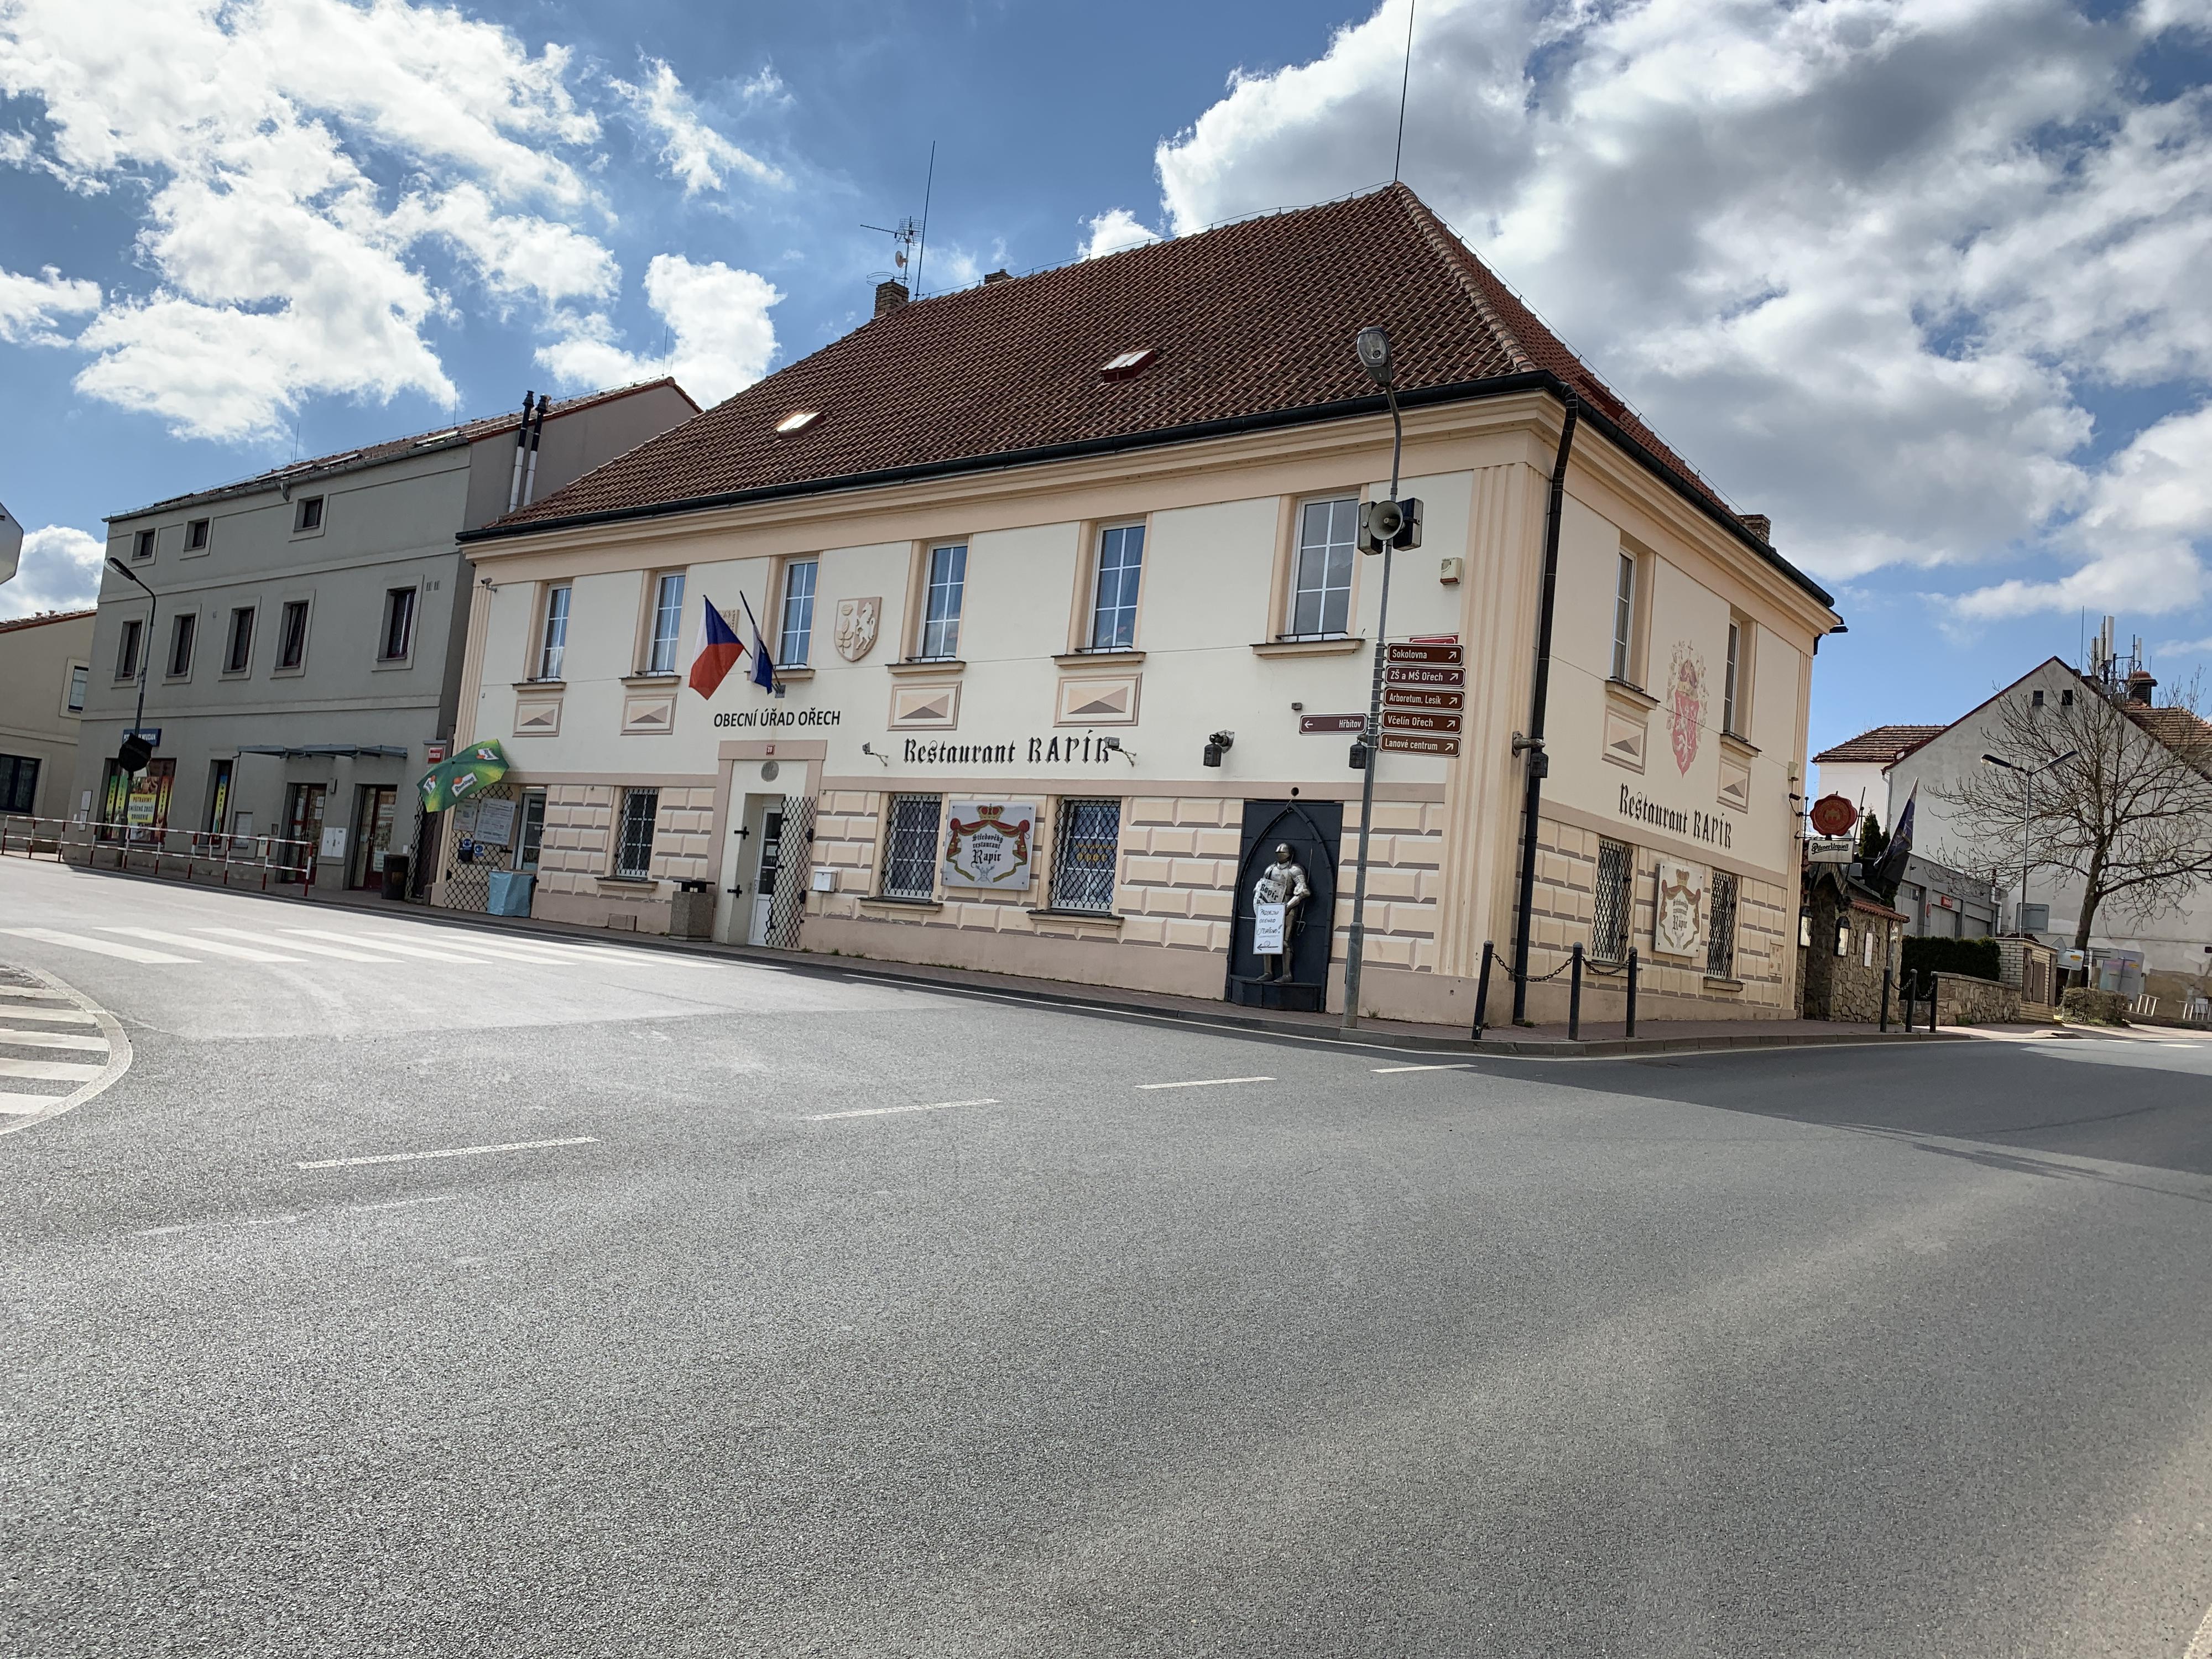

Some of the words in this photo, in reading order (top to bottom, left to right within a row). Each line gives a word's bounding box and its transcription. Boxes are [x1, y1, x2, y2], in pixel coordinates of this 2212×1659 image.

[1392, 649, 1427, 659] Sokolovna
[1390, 669, 1400, 680] ZŠ
[1408, 670, 1420, 680] MŠ
[1422, 672, 1443, 681] Ořech
[1425, 695, 1441, 705] Lesík
[714, 708, 758, 727] OBECNÍ
[760, 708, 795, 726] ÚŘAD
[799, 707, 841, 726] OŘECH
[1387, 715, 1410, 725] Včelín
[1412, 717, 1433, 727] Ořech
[1339, 719, 1361, 728] Hřbitov
[903, 738, 1016, 764] Restaurant
[1026, 729, 1110, 764] RAPÍR
[1385, 738, 1408, 747] Lanové
[1410, 741, 1438, 750] centrum
[1619, 782, 1688, 835] Restaurant
[1693, 810, 1731, 849] RAPÍR
[972, 833, 1004, 843] Středověký
[1811, 842, 1831, 854] Pilsner
[1830, 842, 1849, 852] Urquell
[971, 849, 1001, 868] Rapír
